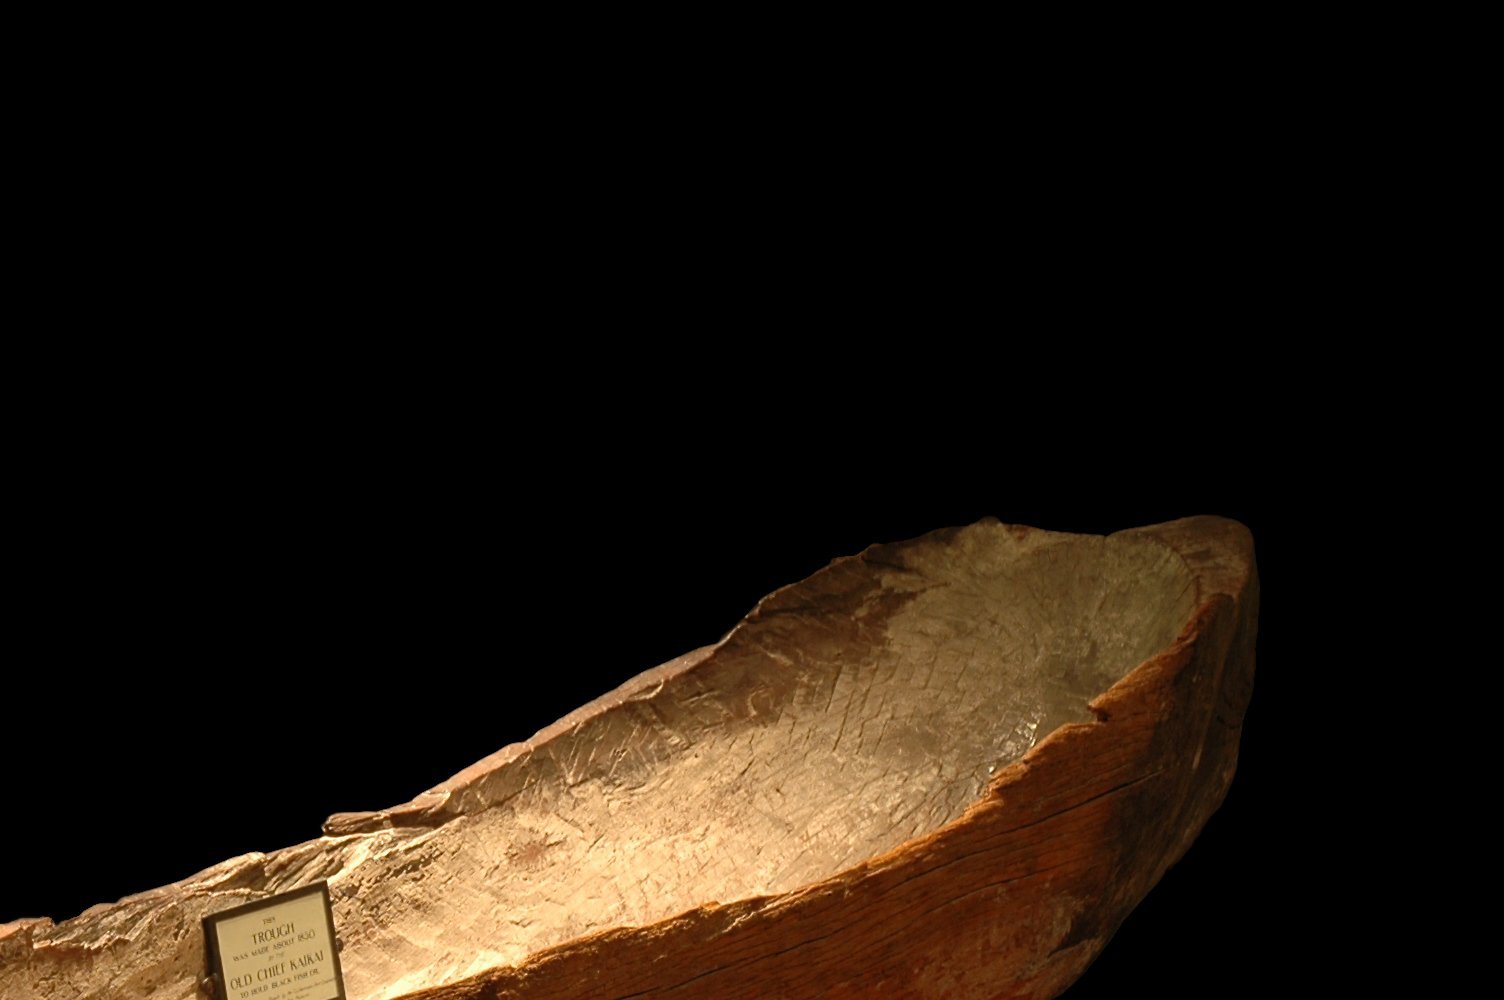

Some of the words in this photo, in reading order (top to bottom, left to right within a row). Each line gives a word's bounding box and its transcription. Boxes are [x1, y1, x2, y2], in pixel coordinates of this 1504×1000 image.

[252, 923, 295, 945] TROUGH
[232, 953, 249, 961] WAS
[251, 946, 269, 957] MADE
[272, 939, 295, 950] ABOUT
[229, 974, 252, 990] OLD
[256, 962, 286, 981] CHIEF
[250, 985, 269, 996] HOLD
[271, 976, 292, 989] BLACK
